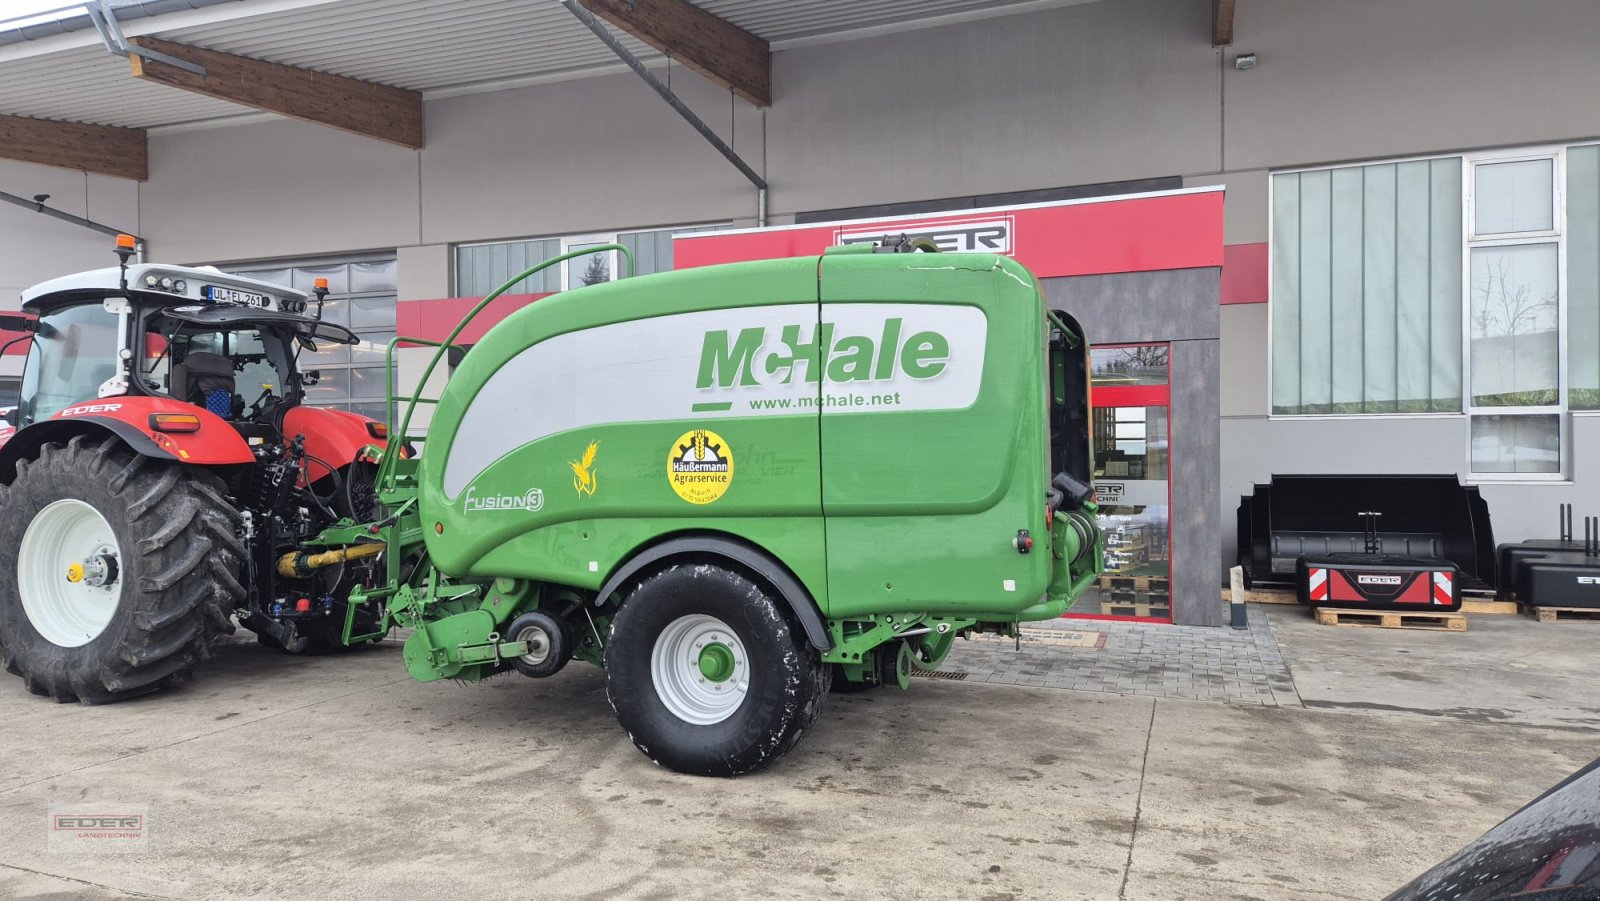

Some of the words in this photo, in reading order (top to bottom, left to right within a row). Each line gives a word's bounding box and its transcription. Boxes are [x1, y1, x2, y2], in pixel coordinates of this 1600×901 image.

[214, 288, 226, 300] UL
[245, 294, 261, 306] 261
[696, 317, 949, 388] McHale
[749, 392, 901, 410] www.mchale.net
[61, 403, 123, 417] EDER
[673, 461, 727, 472] Häußermann
[674, 473, 727, 485] Agrarservice
[1095, 485, 1122, 493] ER
